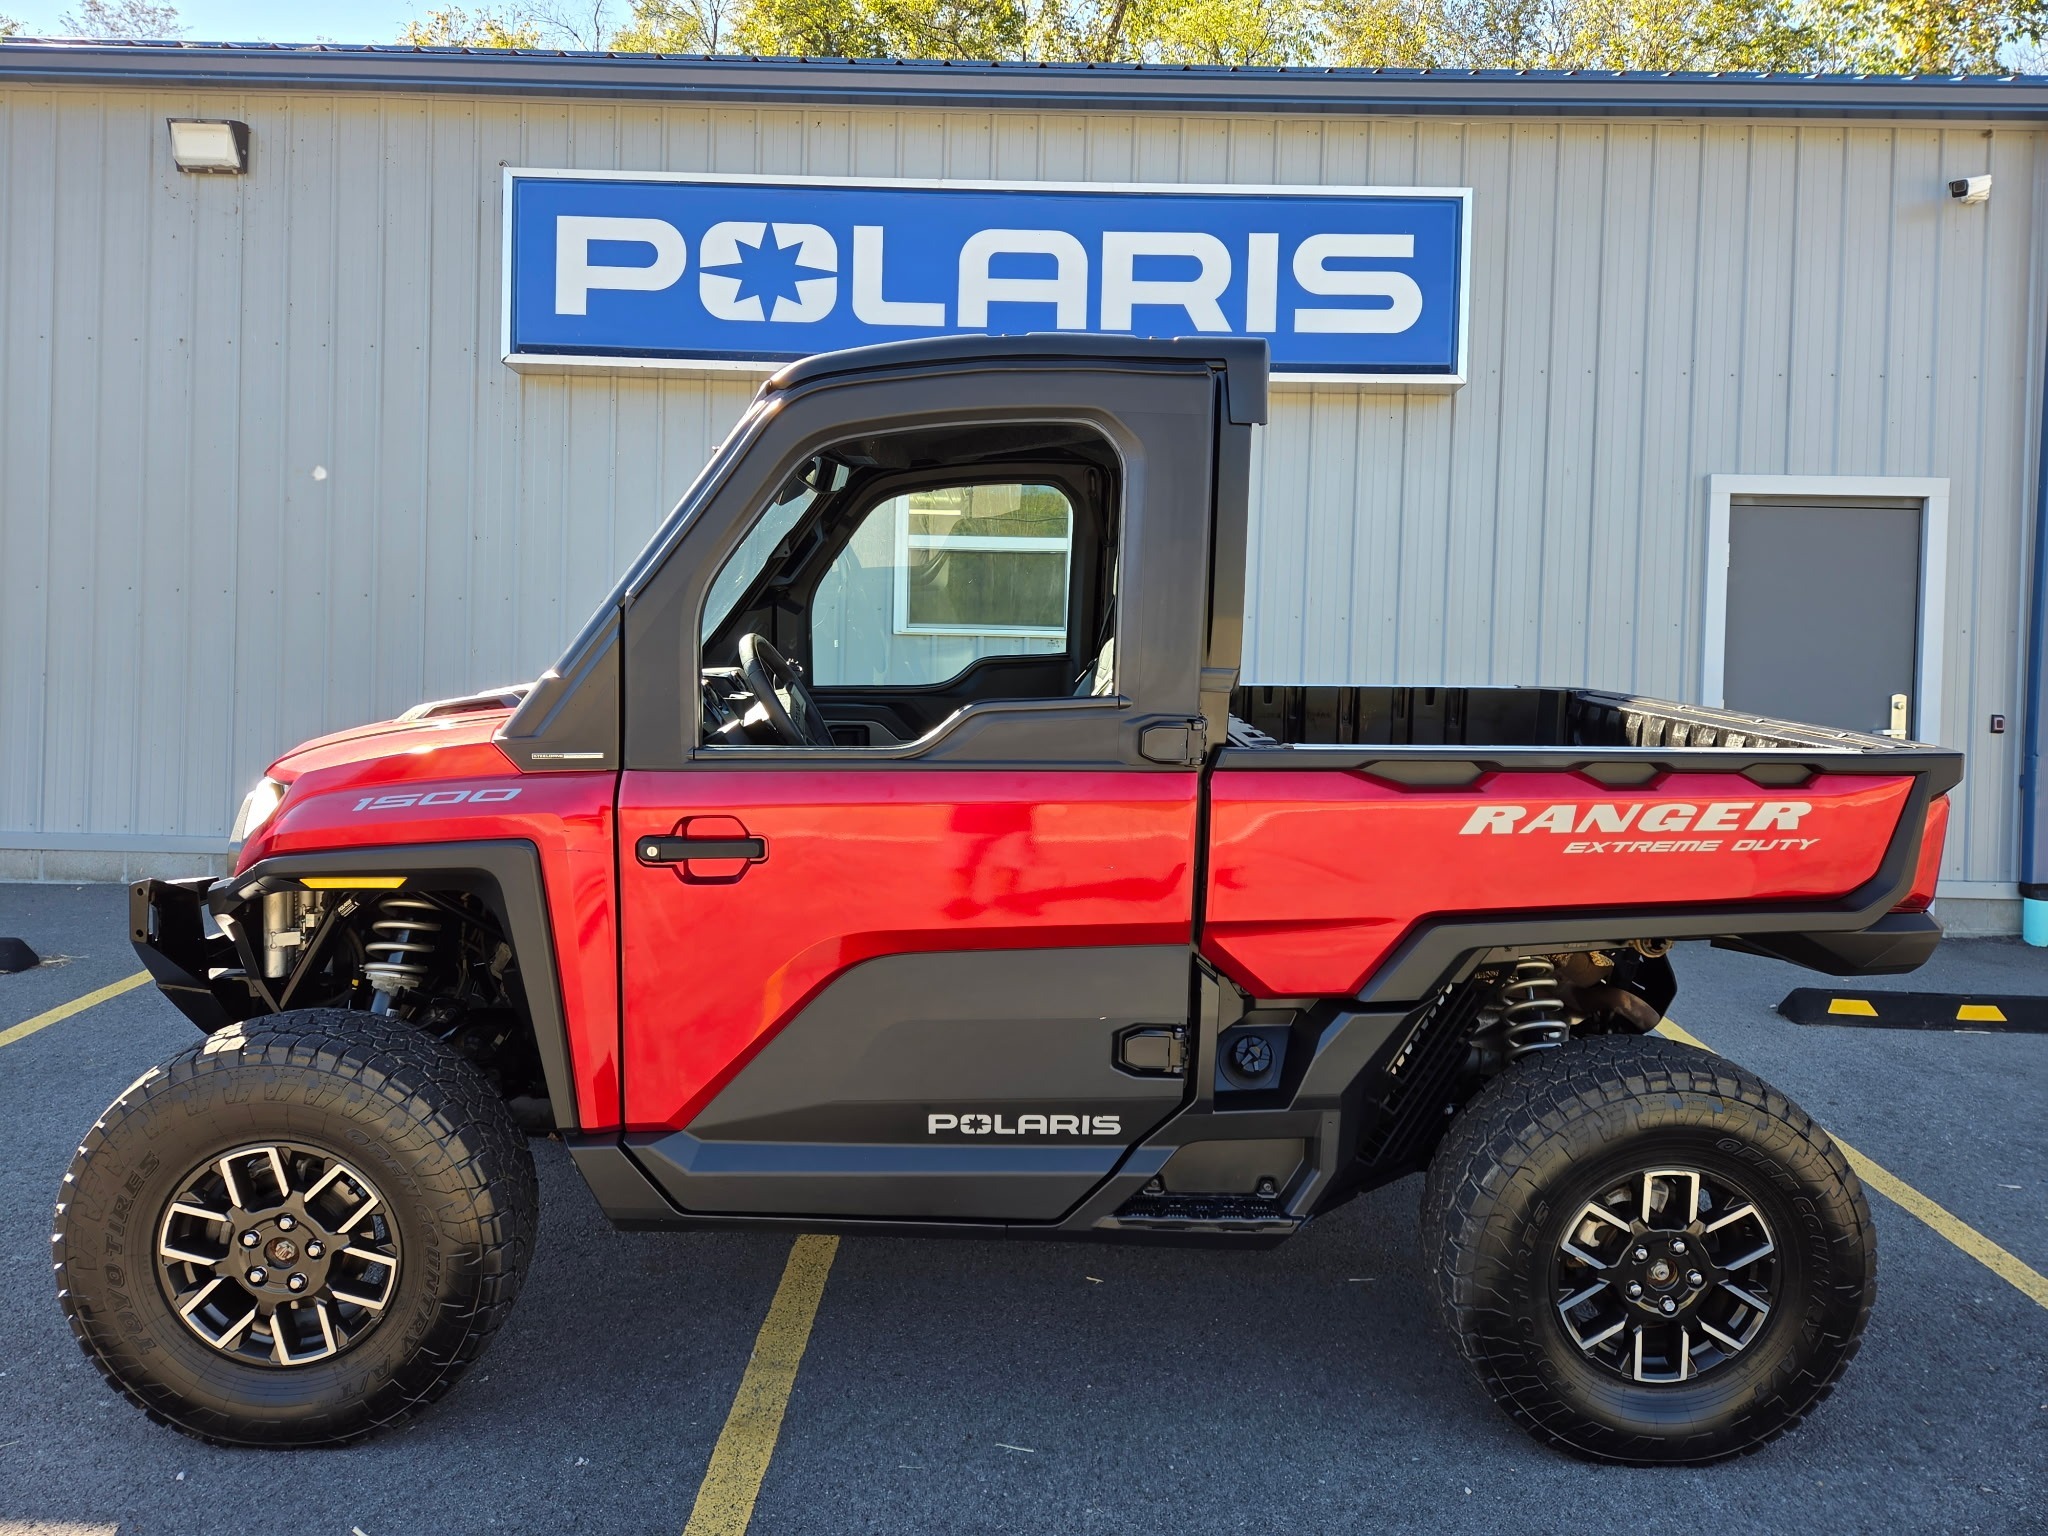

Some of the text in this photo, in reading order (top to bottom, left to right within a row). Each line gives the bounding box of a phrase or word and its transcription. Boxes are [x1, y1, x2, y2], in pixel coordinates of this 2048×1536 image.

[555, 215, 1423, 333] POLARIS
[352, 788, 522, 811] 1500
[1459, 802, 1813, 834] RANGER
[1563, 838, 1820, 853] EXTREME DUTY
[928, 1114, 1121, 1135] POLARIS
[104, 1150, 160, 1355] TOYO TIRES
